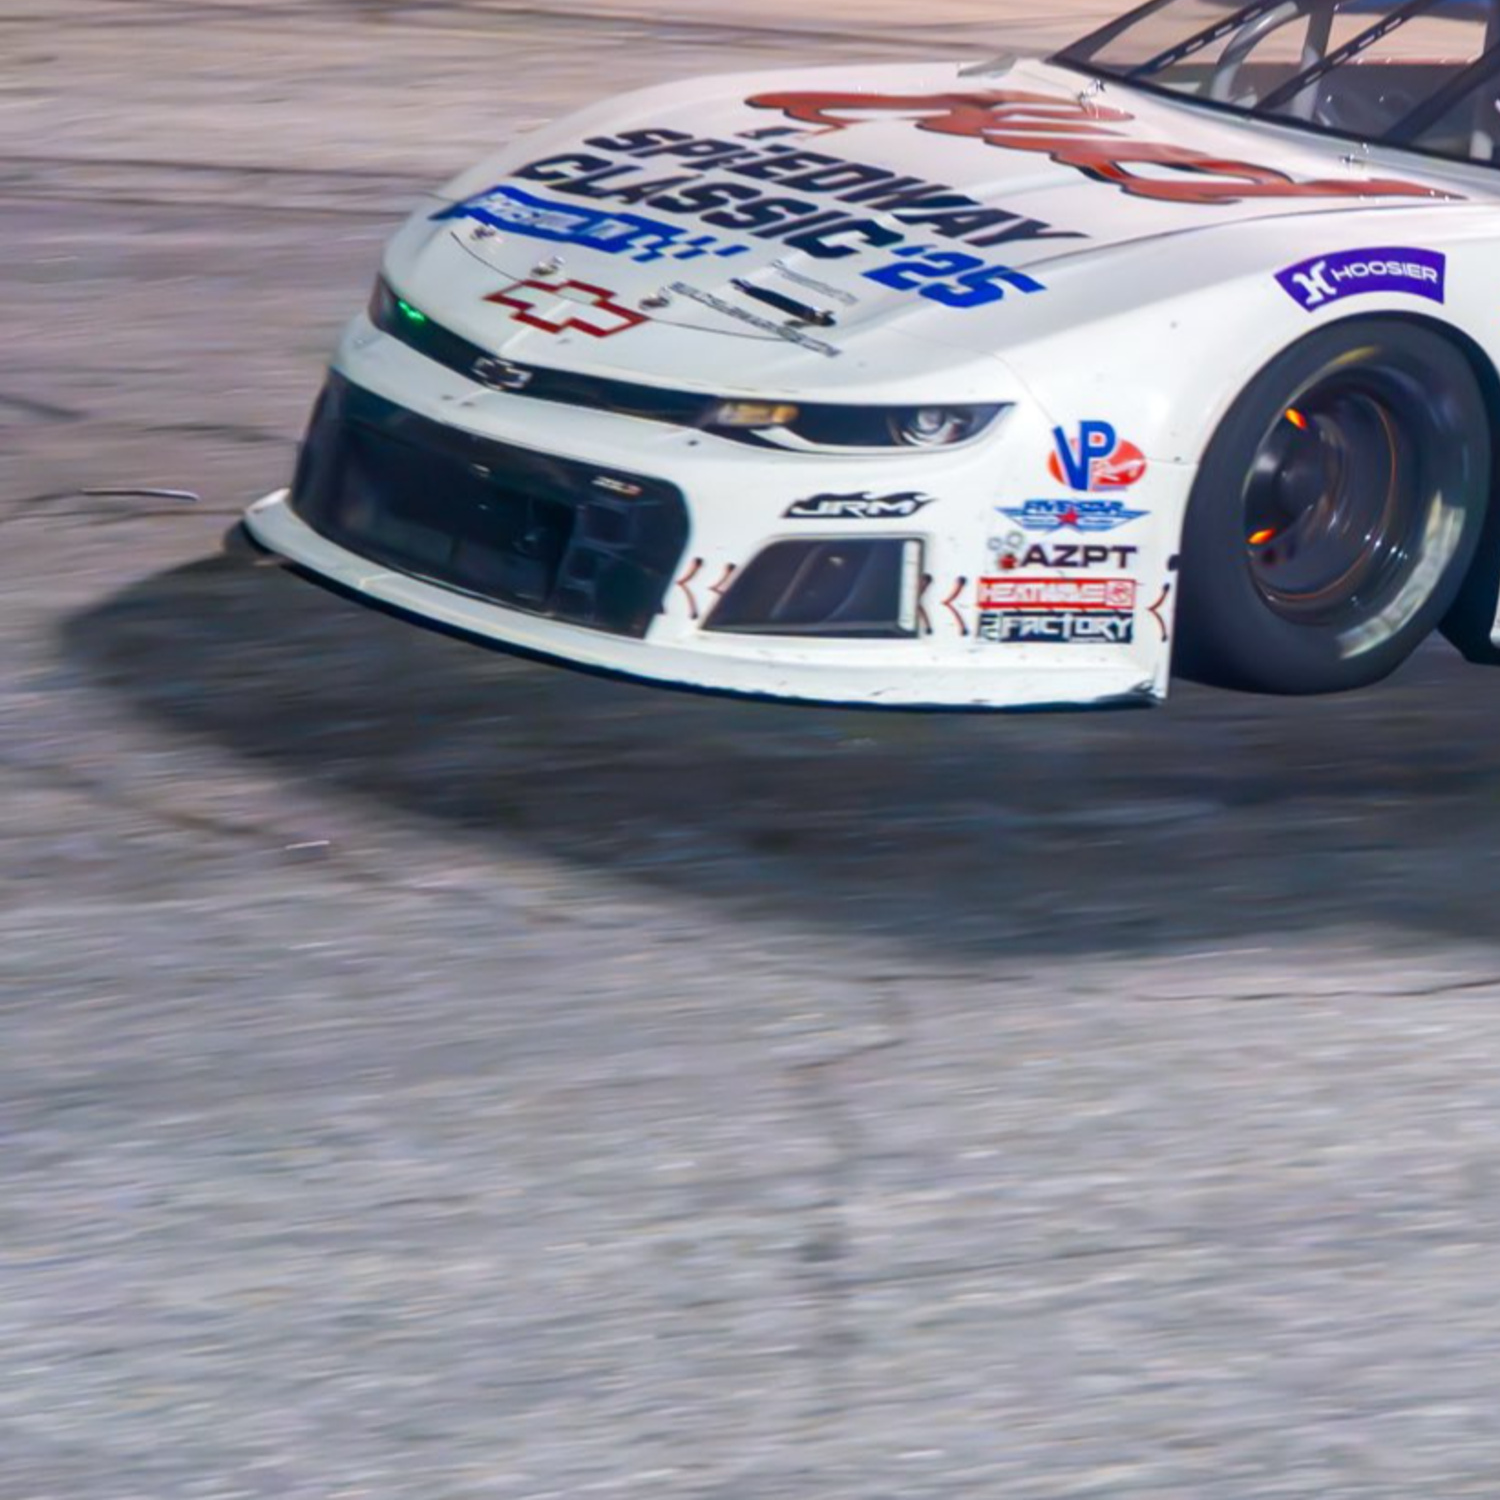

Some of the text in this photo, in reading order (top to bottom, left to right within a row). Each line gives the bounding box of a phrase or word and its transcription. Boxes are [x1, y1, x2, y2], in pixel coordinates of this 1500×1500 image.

[508, 152, 905, 260] CLASSIC
[584, 128, 1092, 248] SPEEDWAY
[1329, 260, 1438, 284] HOOSIER
[1052, 420, 1117, 492] VP
[1020, 542, 1138, 569] AZPT
[1001, 613, 1134, 641] FACTORY
